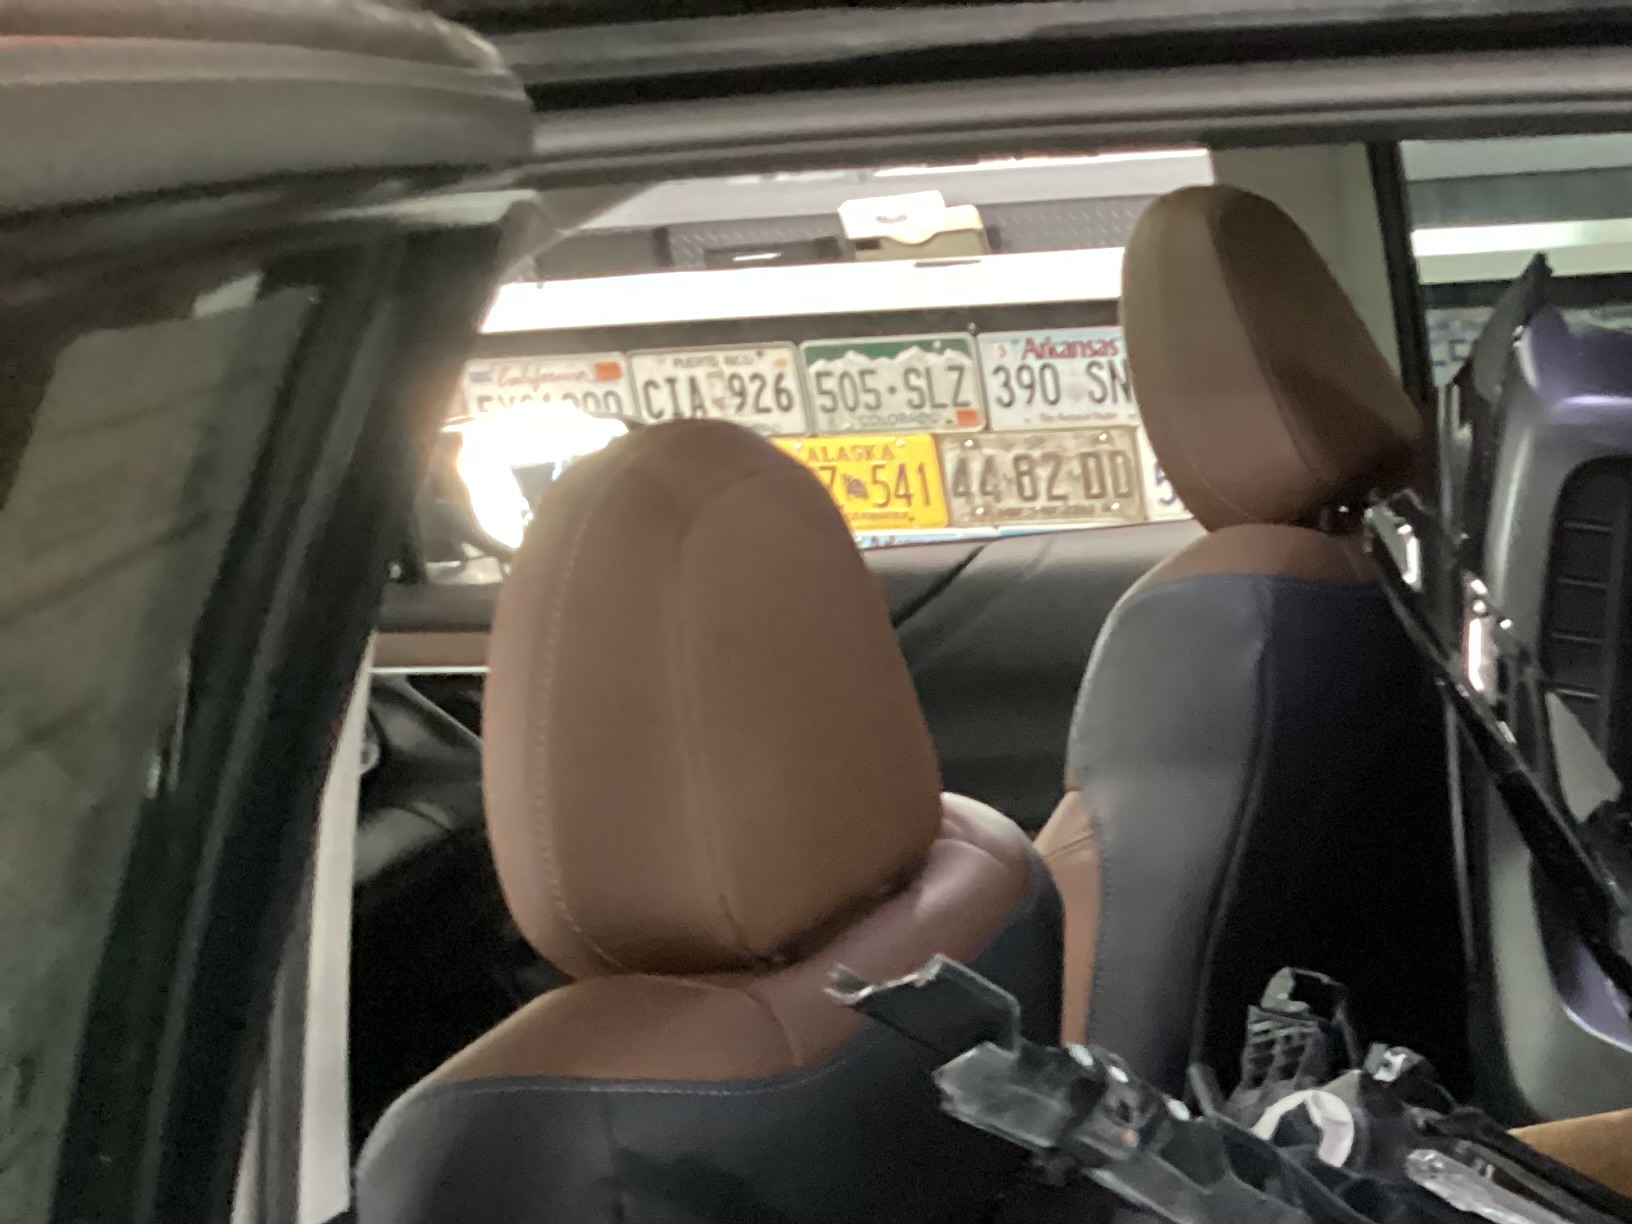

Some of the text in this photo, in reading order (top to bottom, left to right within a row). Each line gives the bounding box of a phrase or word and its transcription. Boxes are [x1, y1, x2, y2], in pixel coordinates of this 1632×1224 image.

[1022, 336, 1119, 360] Arkansas
[643, 376, 708, 419] CIA
[728, 371, 794, 413] 926
[992, 362, 1062, 408] 390
[808, 444, 896, 462] ALASKA
[871, 462, 932, 508] 541
